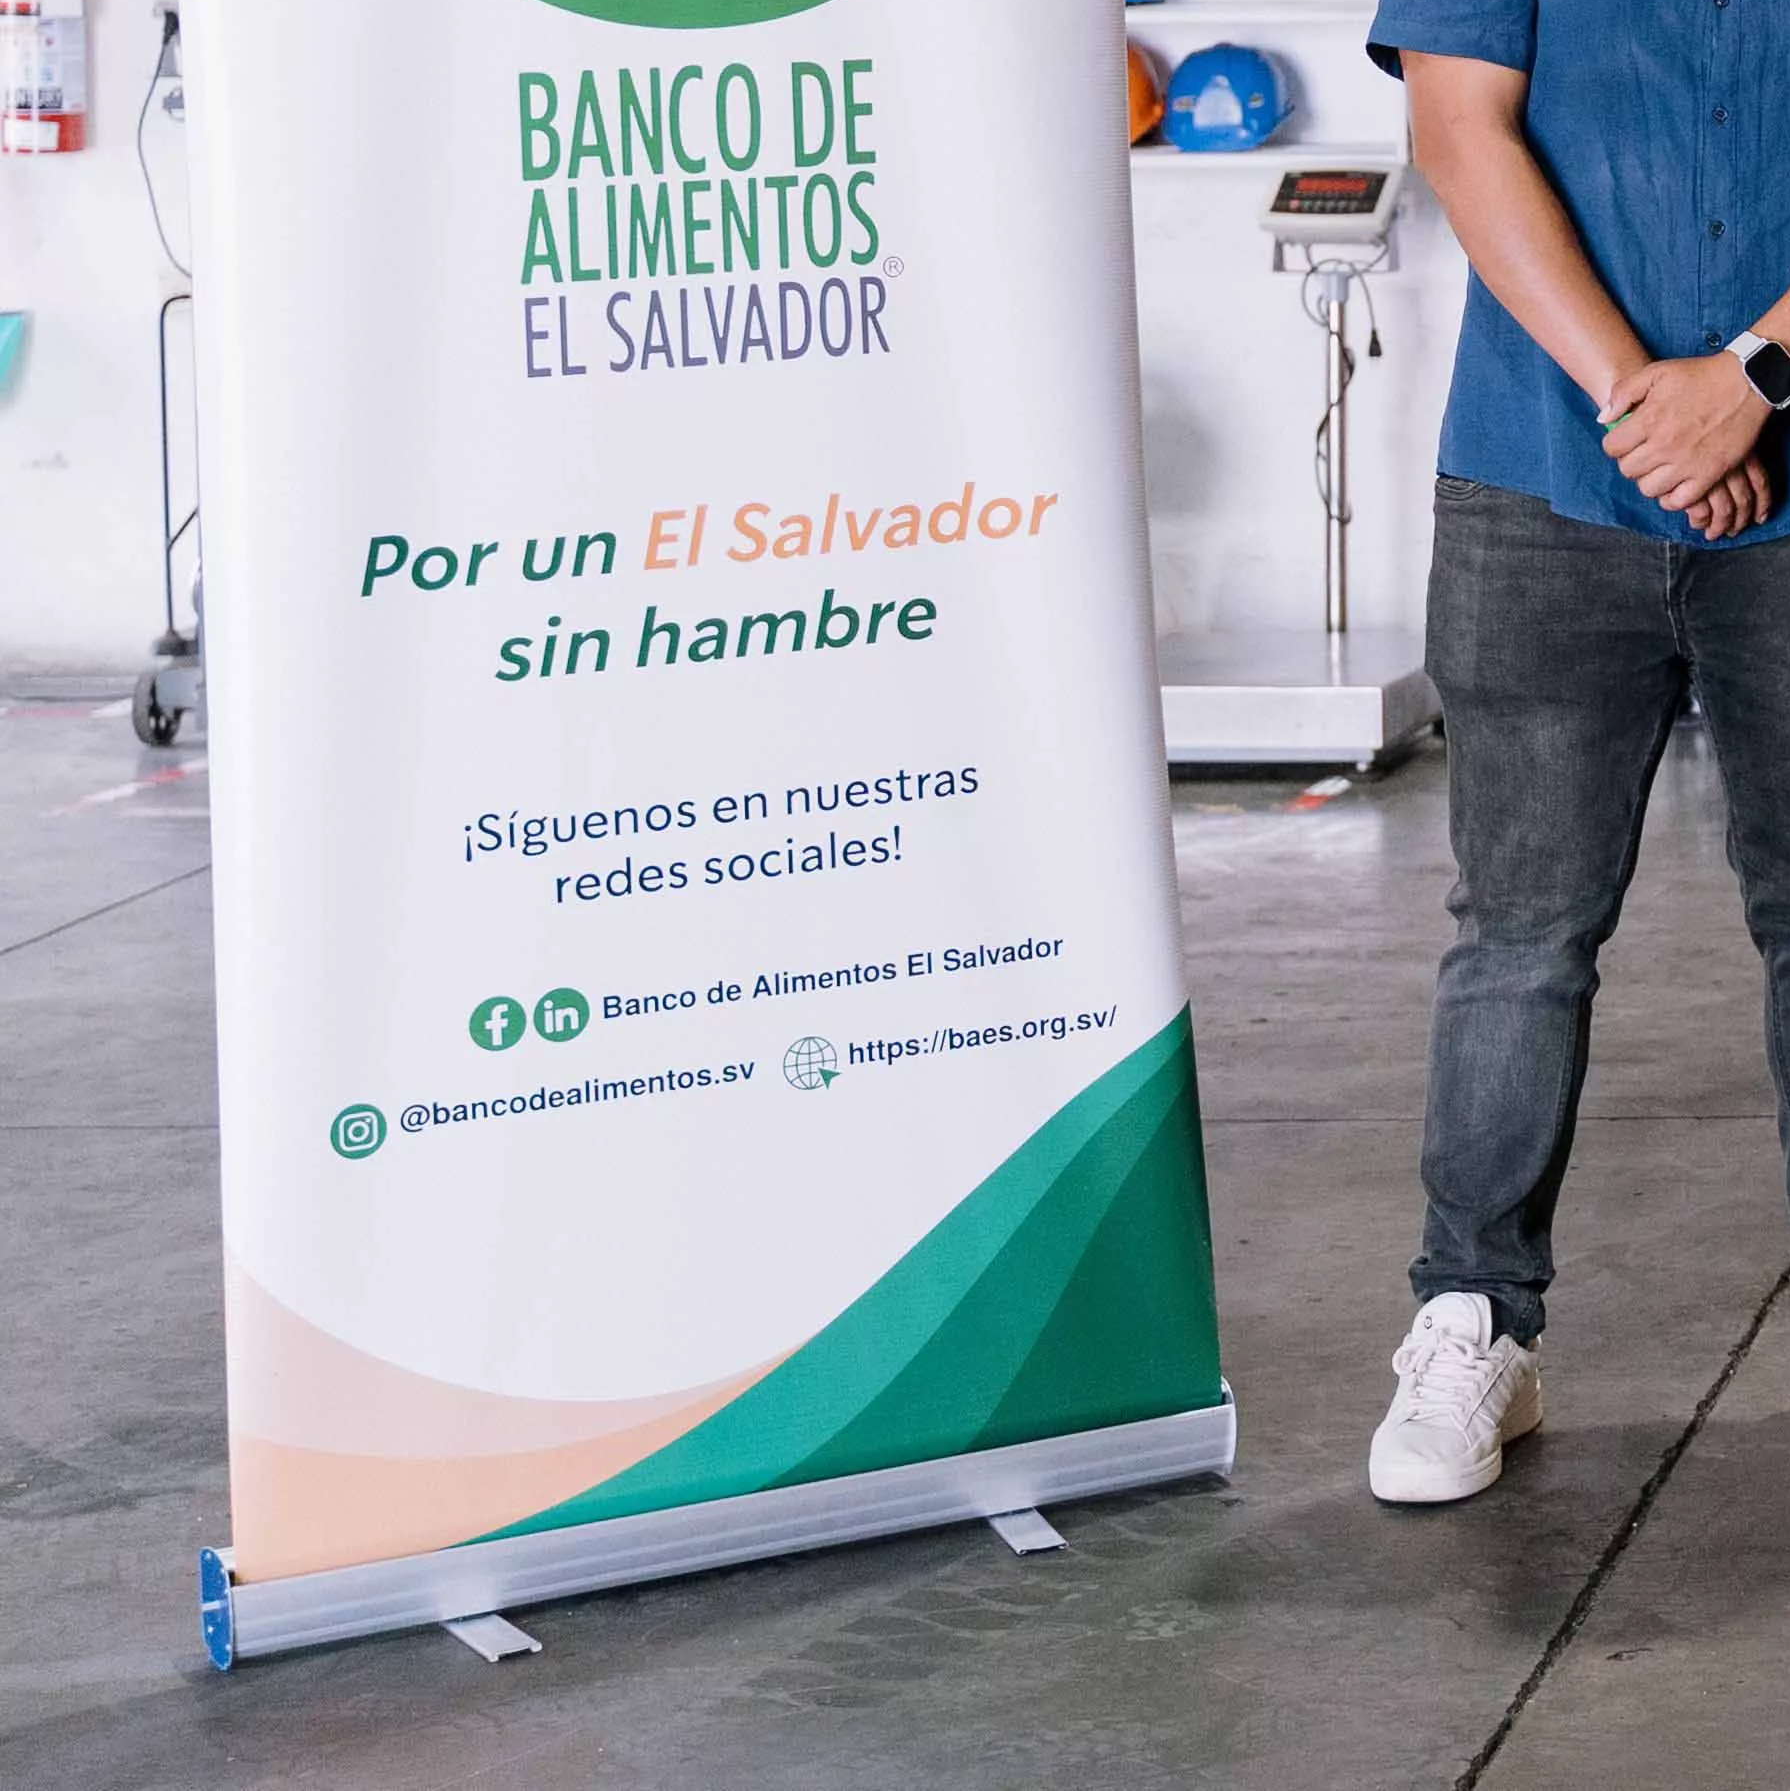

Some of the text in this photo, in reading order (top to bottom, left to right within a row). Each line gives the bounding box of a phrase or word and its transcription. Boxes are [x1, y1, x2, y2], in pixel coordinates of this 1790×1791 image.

[519, 59, 877, 180] BANCO DE
[520, 172, 880, 285] ALIMENTOS
[524, 275, 891, 378] EL SALVADOR
[360, 481, 1058, 597] Por un El Salvador
[494, 589, 938, 682] sin hambre
[465, 764, 980, 862] ¡Síguenos en nuestras
[554, 825, 902, 904] redes sociales!
[602, 990, 697, 1021] Banco
[706, 979, 743, 1005] de
[752, 957, 897, 999] Alimentos
[907, 951, 933, 976] El
[942, 937, 1064, 973] Salvador
[399, 1004, 1118, 1135] @bancodealimentos.sv https://baes.org.sv/
